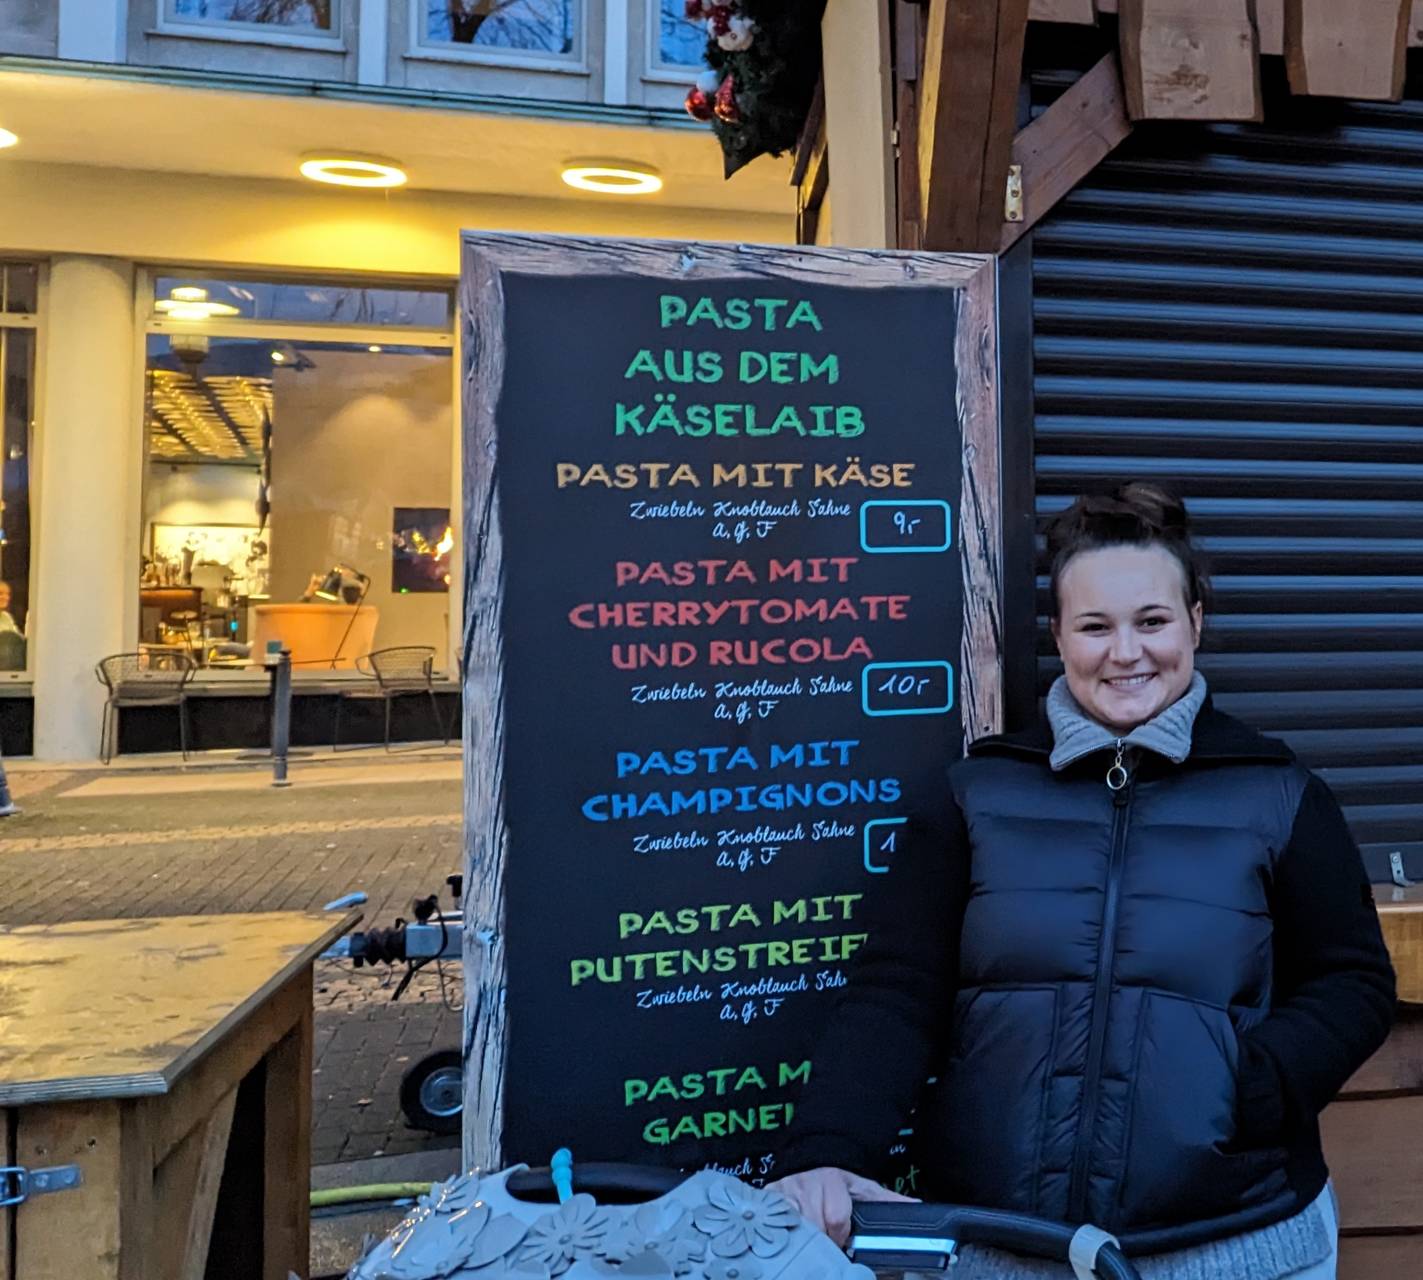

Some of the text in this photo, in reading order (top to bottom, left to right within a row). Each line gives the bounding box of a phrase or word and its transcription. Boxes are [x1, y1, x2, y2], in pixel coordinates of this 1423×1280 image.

[660, 295, 823, 332] PASTA
[624, 349, 839, 384] AUS DEM
[615, 393, 865, 438] KÄSELAIB
[556, 456, 915, 489] PASTA MIT KÄSE
[630, 498, 851, 520] Zwiebeln Knoblauch Sahne
[616, 557, 858, 586] PASTA MIT
[569, 595, 910, 628] CHERRYTOMATE
[612, 637, 874, 669] UND RUCOLA
[631, 675, 853, 704] Zwiebeln Knoblauch Sahne
[616, 739, 860, 778] PASTA MIT
[581, 778, 902, 822] CHAMPIGNONS
[633, 820, 855, 853] Zwiebeln Knoblauch Sahne
[879, 831, 896, 852] 1
[619, 894, 863, 939] PASTA MIT
[570, 933, 869, 987] PUTENSTREIF
[636, 984, 713, 1009] Zwiebeln
[720, 973, 809, 998] Knoblauch
[624, 1060, 811, 1108] PASTA M
